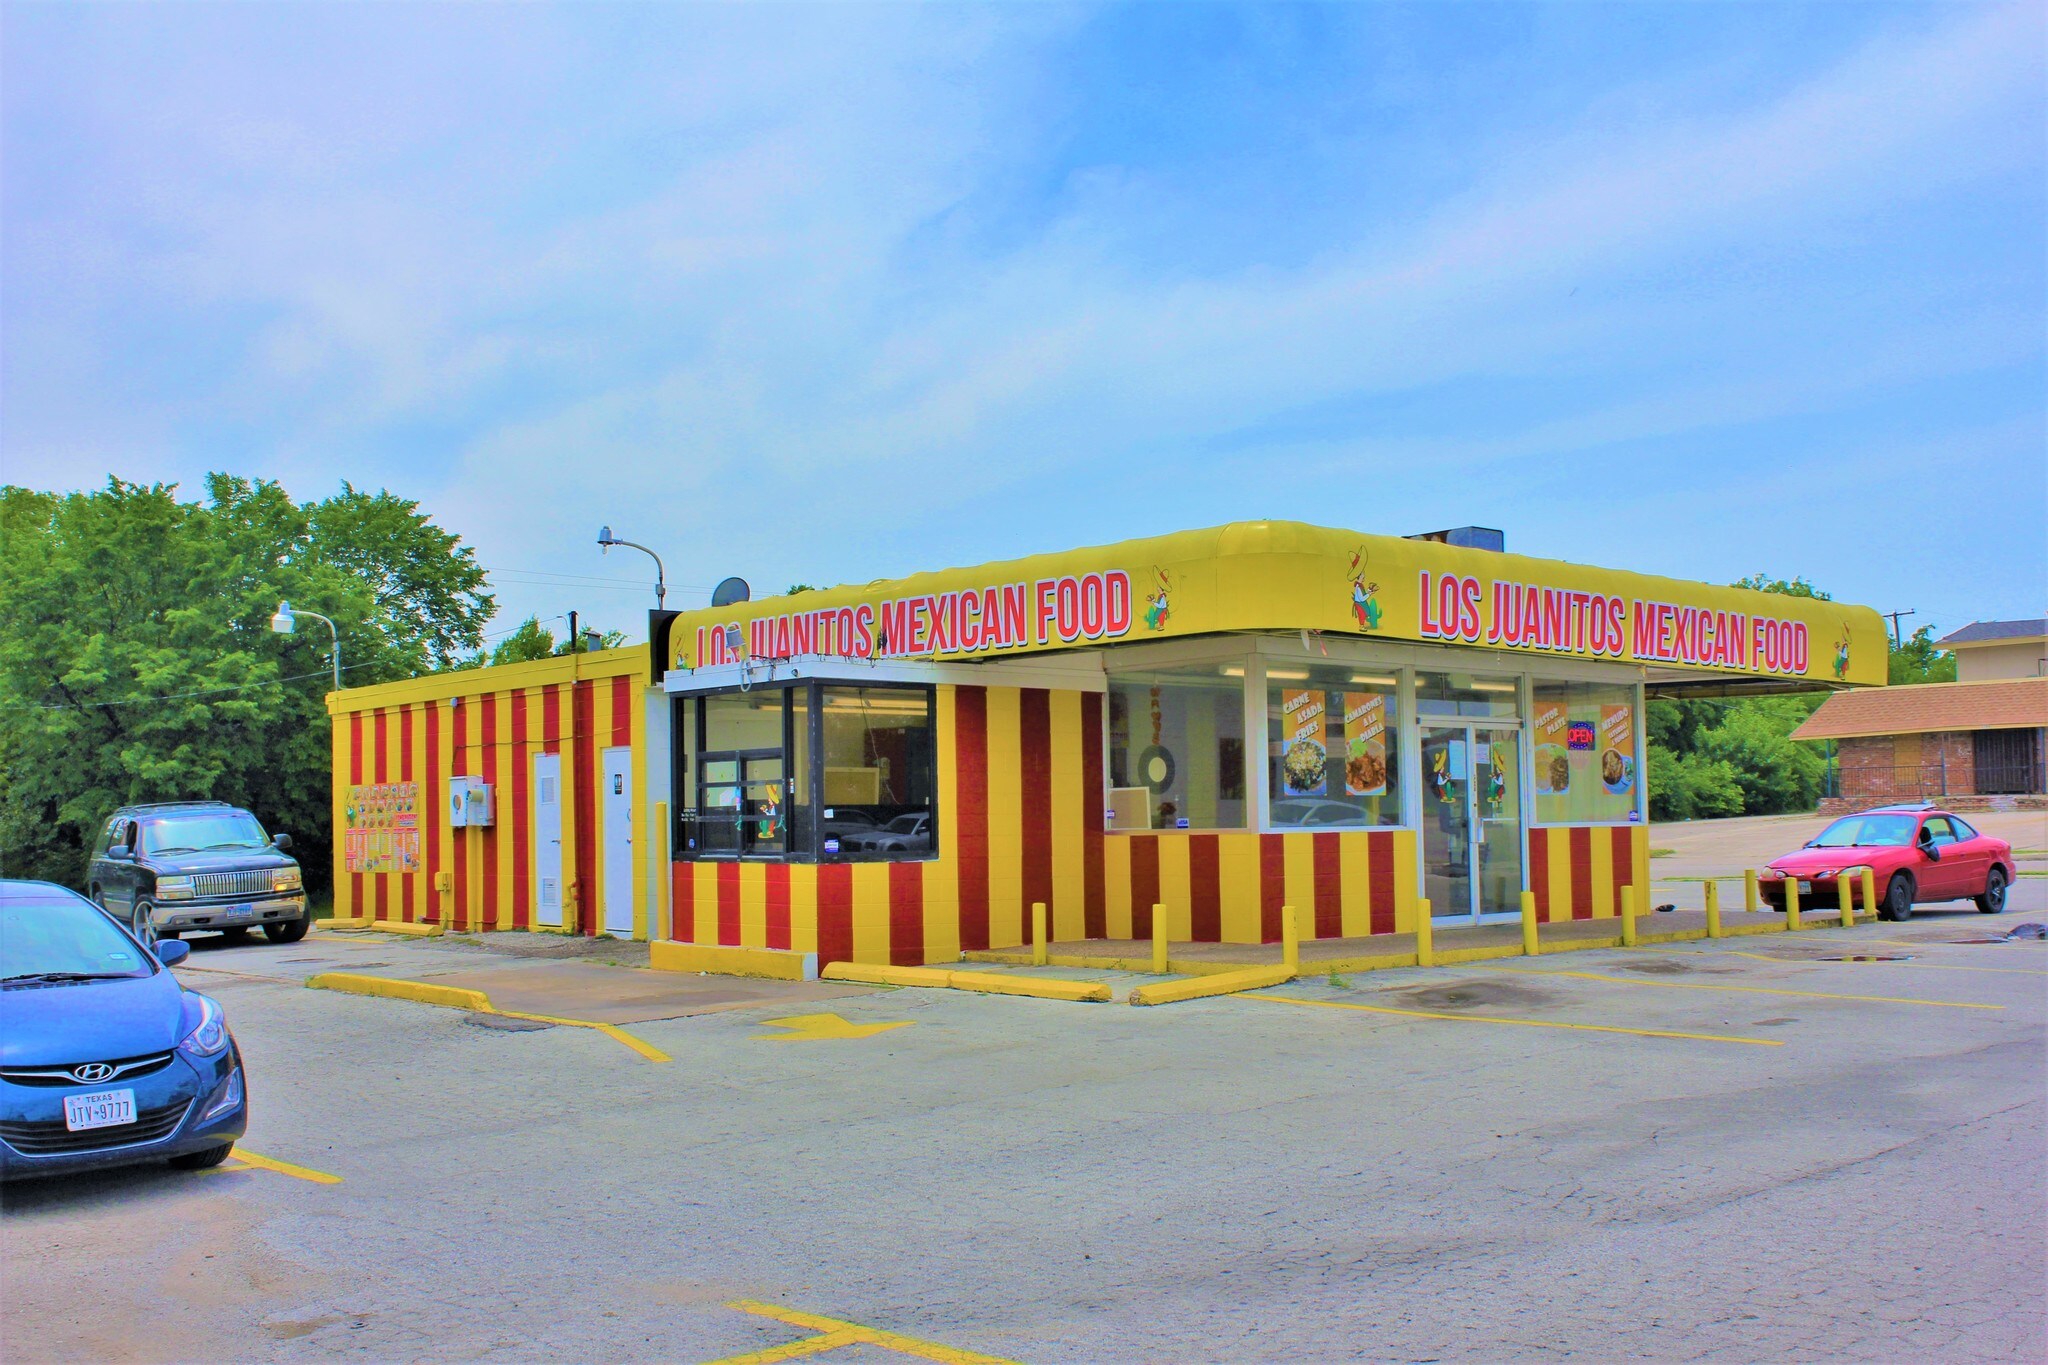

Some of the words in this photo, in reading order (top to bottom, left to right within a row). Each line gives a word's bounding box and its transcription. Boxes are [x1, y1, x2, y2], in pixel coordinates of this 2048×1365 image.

[880, 582, 1027, 658] MEXICAN
[1035, 569, 1132, 645] FOOD
[1419, 569, 1482, 643] LOS
[1486, 579, 1627, 657] JUANITOS
[1632, 598, 1747, 669] MEXICAN
[1750, 613, 1809, 675] FOOD
[1283, 692, 1311, 714] CARNE
[1297, 702, 1323, 724] ASADA
[1345, 695, 1384, 724] CAMARONES
[1535, 708, 1559, 729] PASTOR
[1547, 716, 1566, 735] PLATE
[1601, 707, 1629, 731] MENUDO
[1296, 721, 1319, 742] FRIES
[1360, 722, 1384, 742] DIABLA
[1568, 729, 1593, 742] OPEN
[86, 1093, 113, 1104] TEXAS
[70, 1106, 92, 1124] JTV
[100, 1101, 130, 1120] 9777
